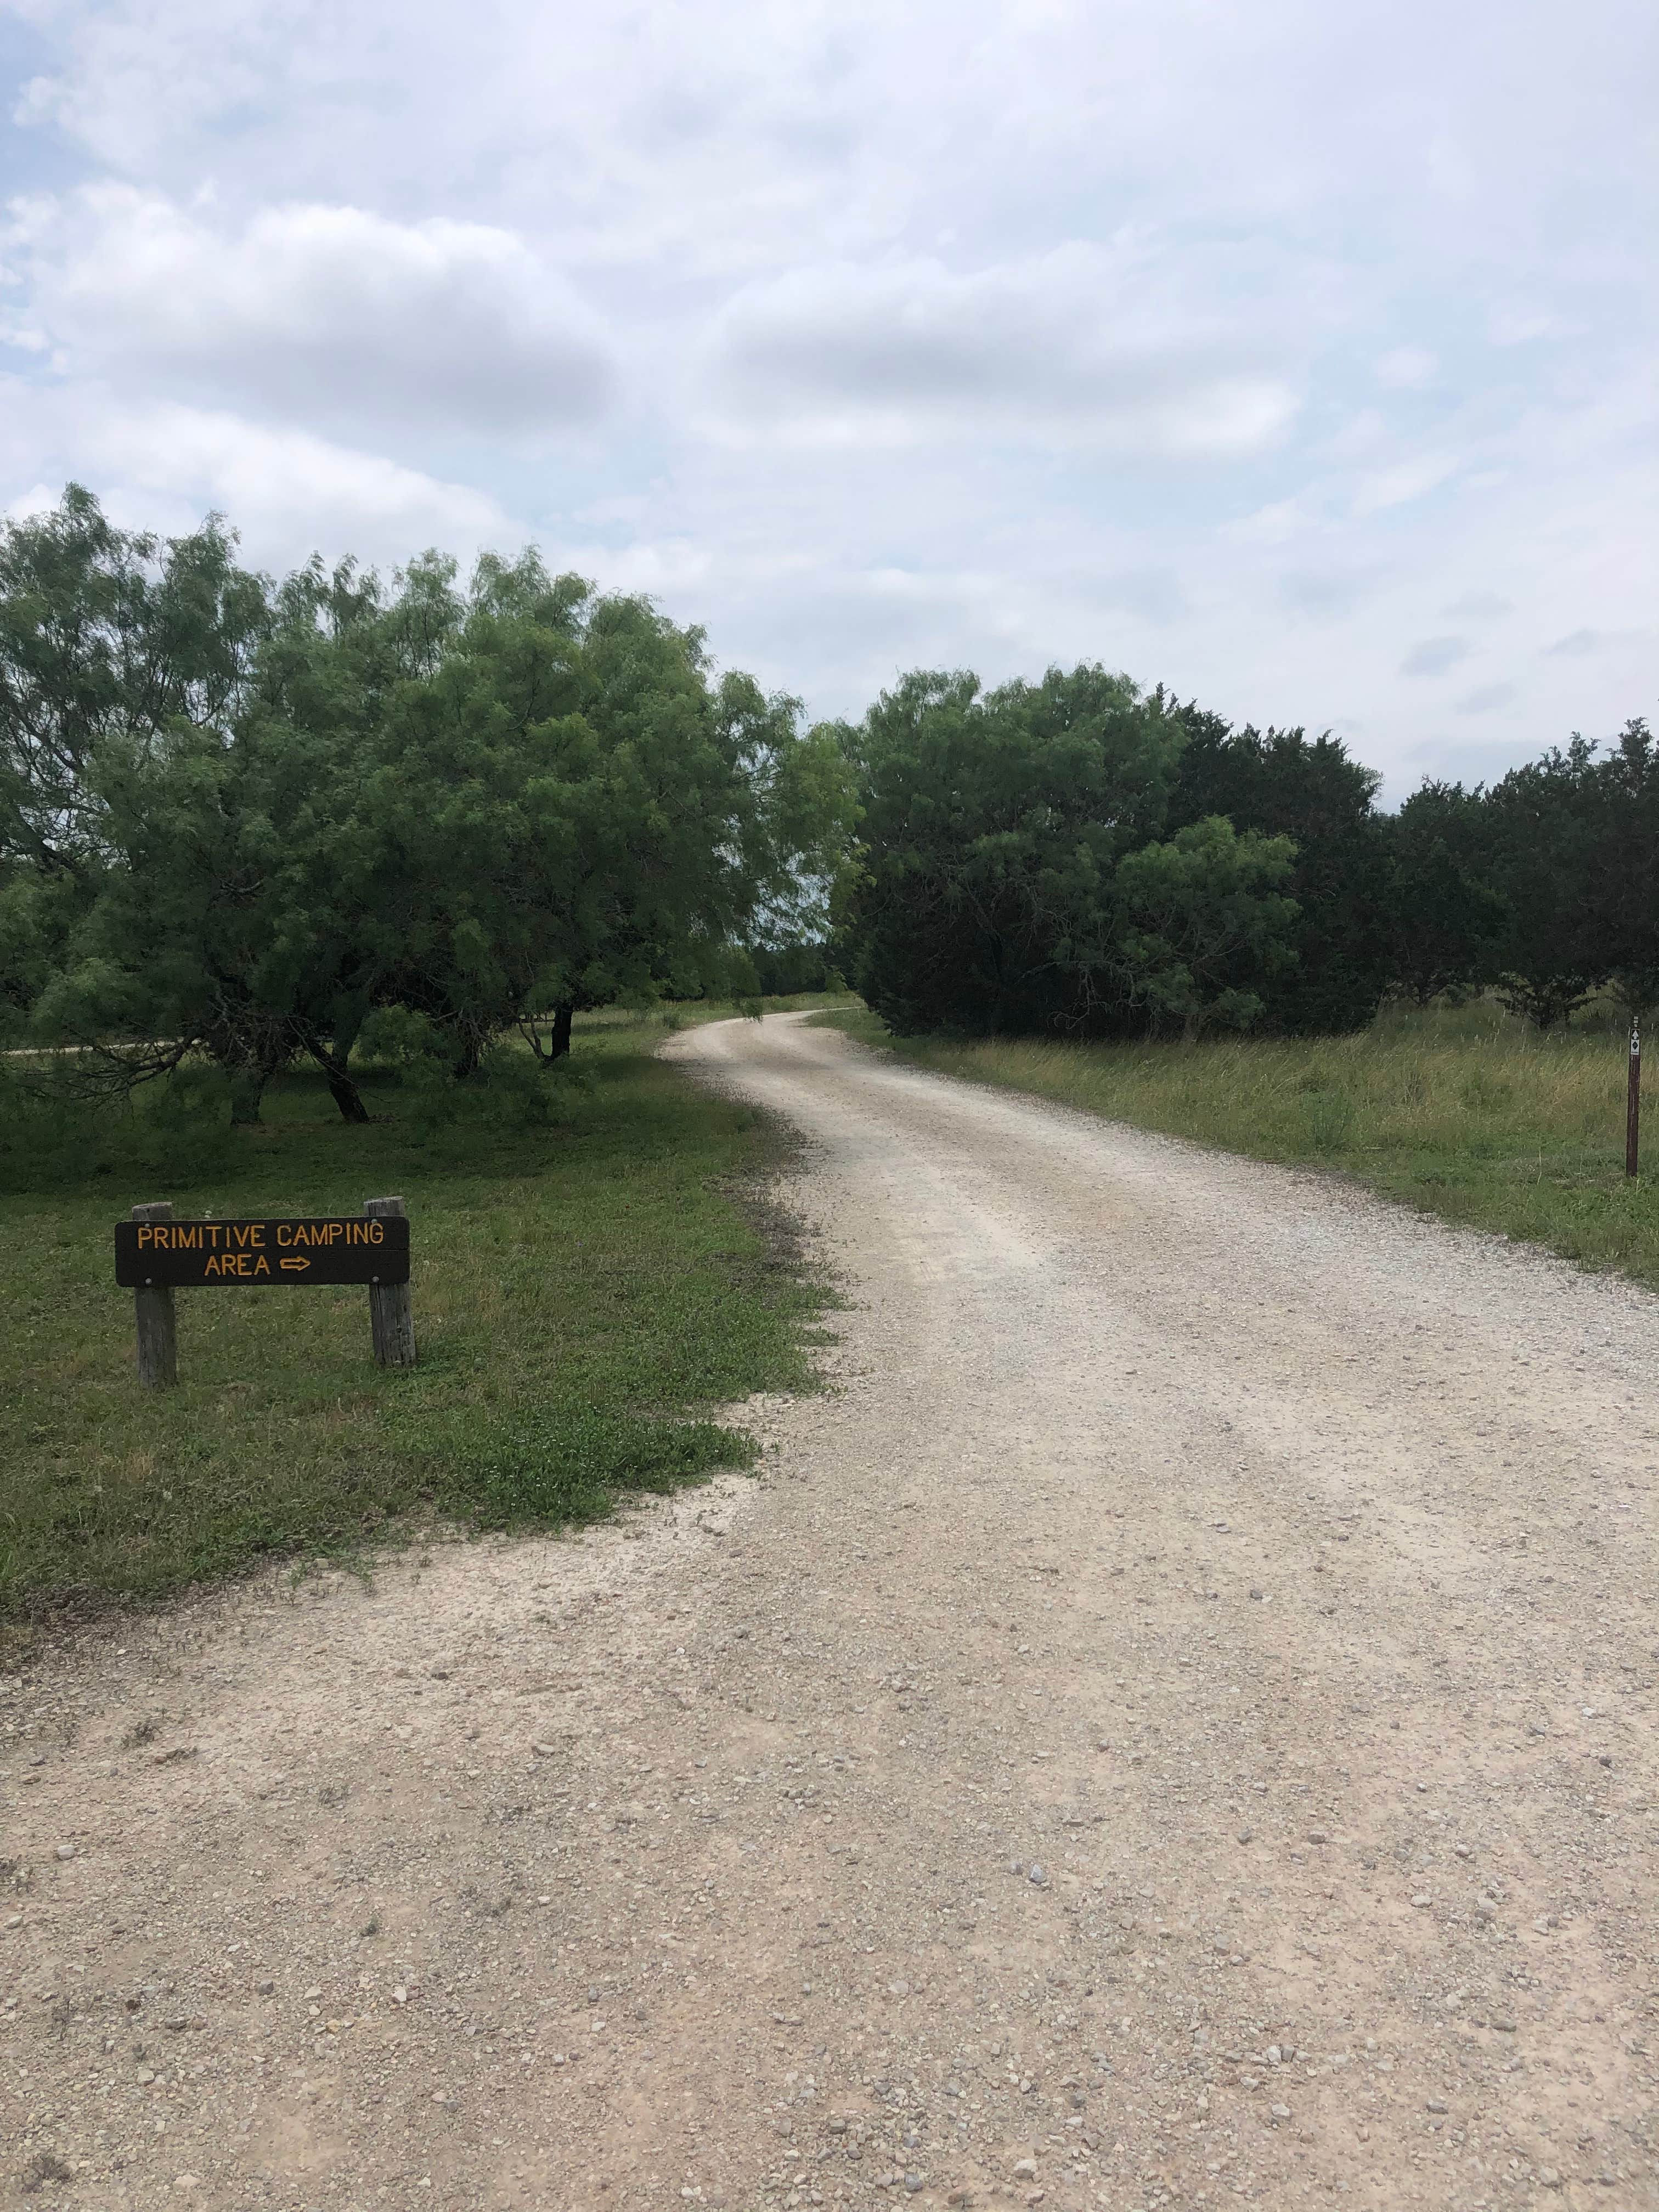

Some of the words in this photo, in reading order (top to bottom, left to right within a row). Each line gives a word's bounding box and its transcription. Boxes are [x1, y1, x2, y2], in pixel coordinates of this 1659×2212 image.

[138, 1225, 266, 1249] PRIMITIVE
[276, 1222, 384, 1246] CAMPING
[204, 1253, 270, 1276] AREA
